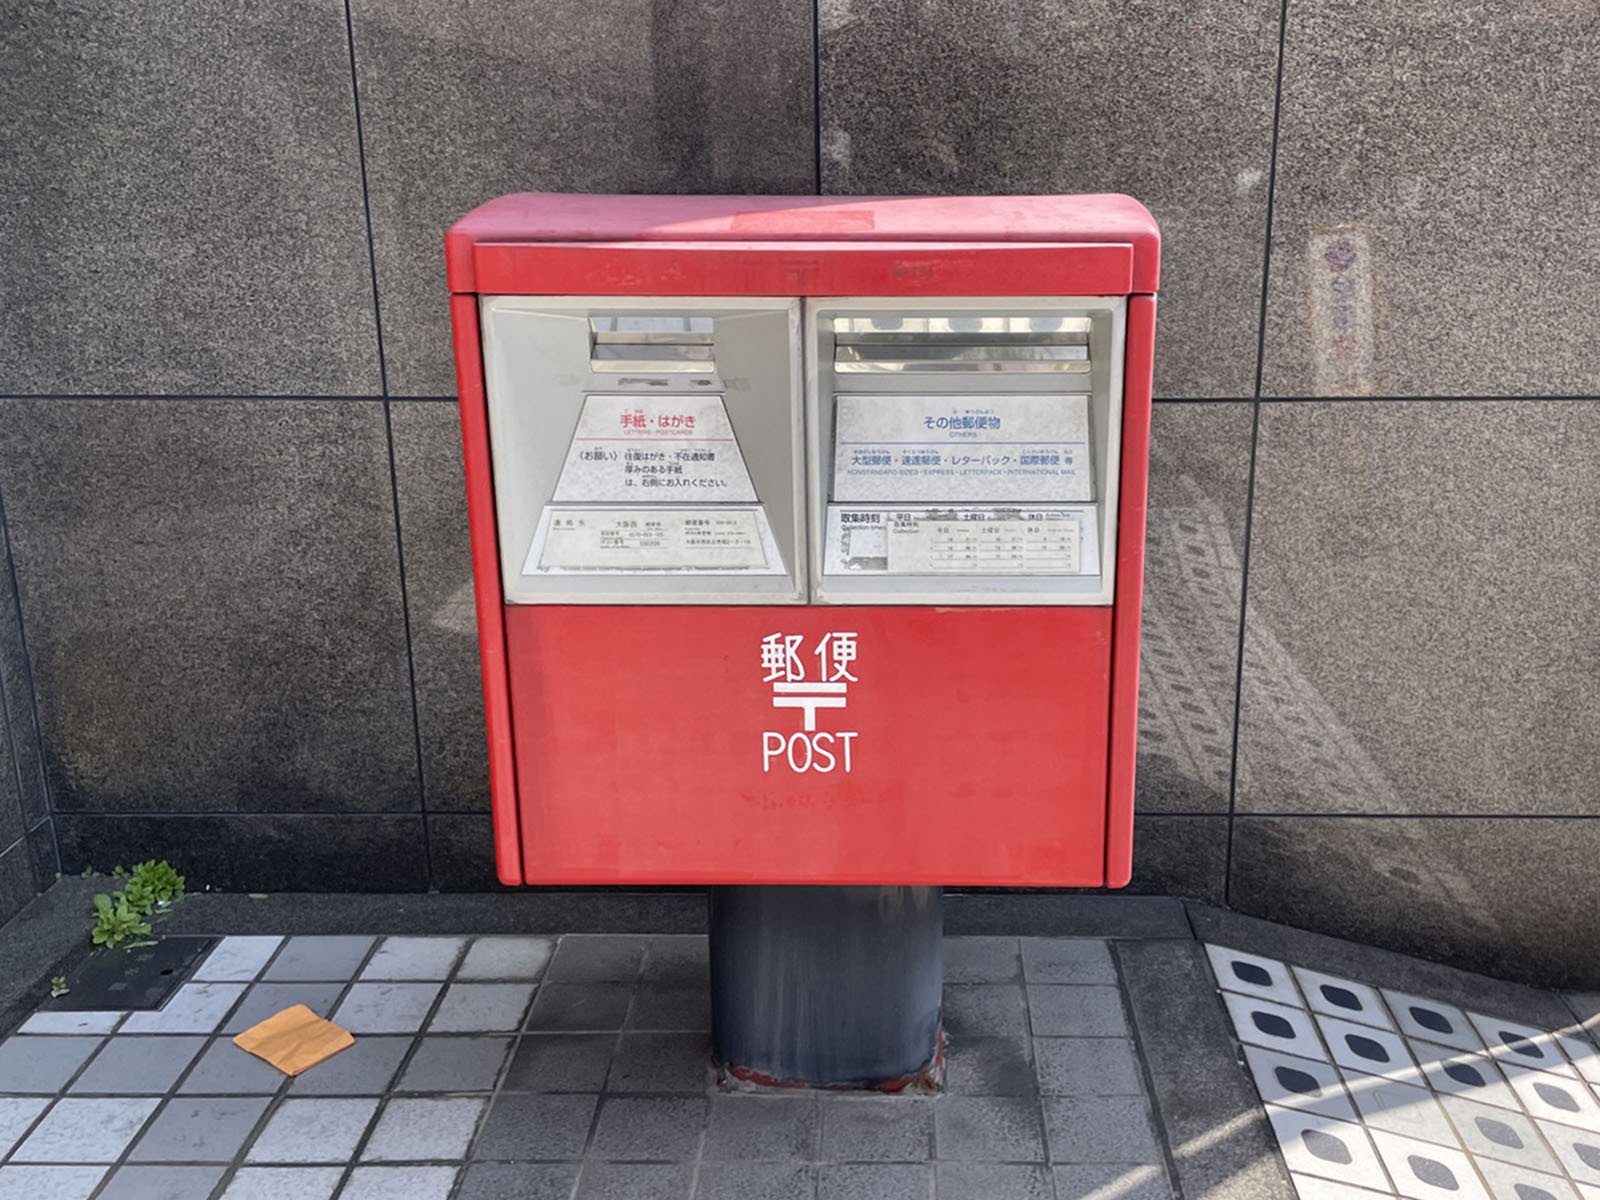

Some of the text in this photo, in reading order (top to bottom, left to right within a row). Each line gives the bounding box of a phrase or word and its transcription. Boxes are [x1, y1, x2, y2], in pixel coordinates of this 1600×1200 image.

[620, 414, 696, 429] 手紙・はがき
[924, 416, 1000, 430] その他郵便物
[841, 513, 880, 523] 取集時刻
[761, 632, 858, 682] 郵便
[763, 732, 858, 773] POST
